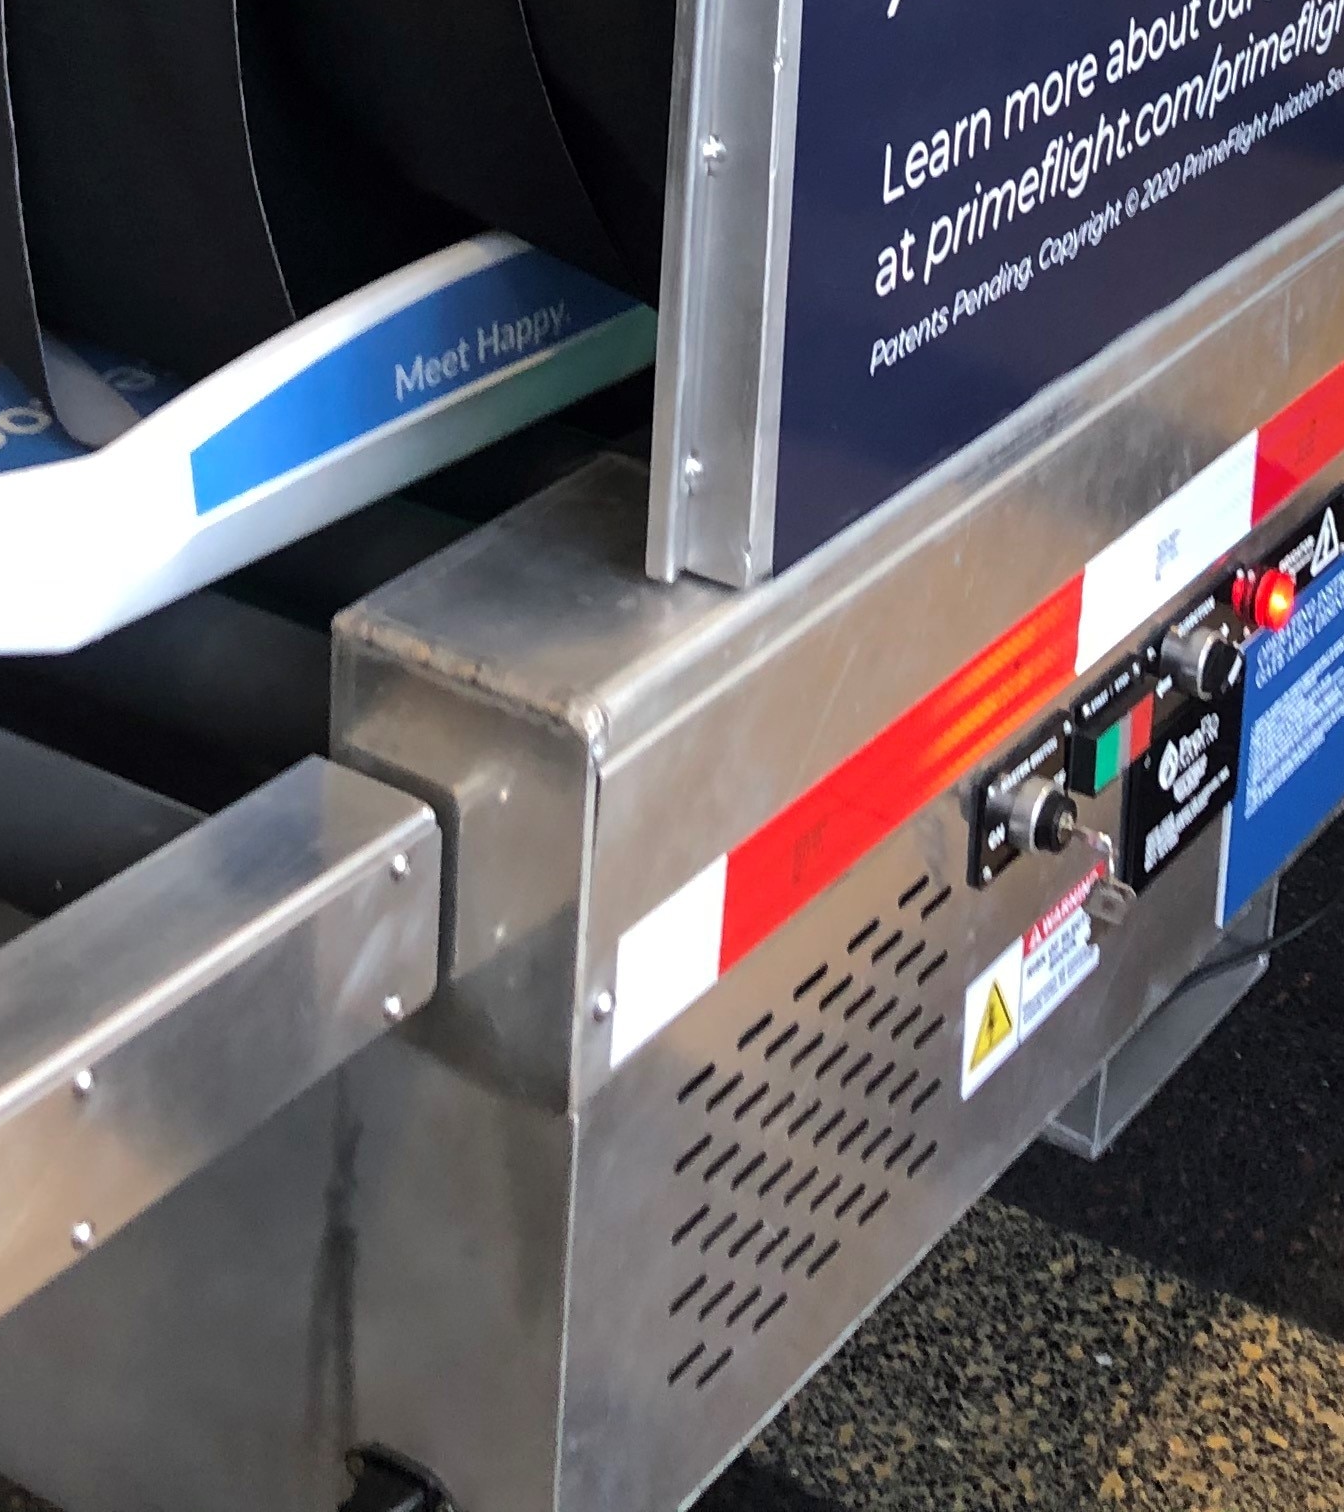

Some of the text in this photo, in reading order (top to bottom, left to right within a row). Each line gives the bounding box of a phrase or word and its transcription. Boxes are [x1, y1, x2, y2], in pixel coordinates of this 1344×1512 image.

[883, 106, 991, 205] Learn
[1004, 52, 1098, 140] more
[870, 306, 949, 377] Patents
[1039, 198, 1123, 272] Copyright
[1140, 161, 1181, 211] 2020
[1182, 111, 1269, 185] PrimeFlight
[1268, 79, 1326, 134] Aviation
[876, 228, 916, 297] at
[394, 336, 471, 403] Meet
